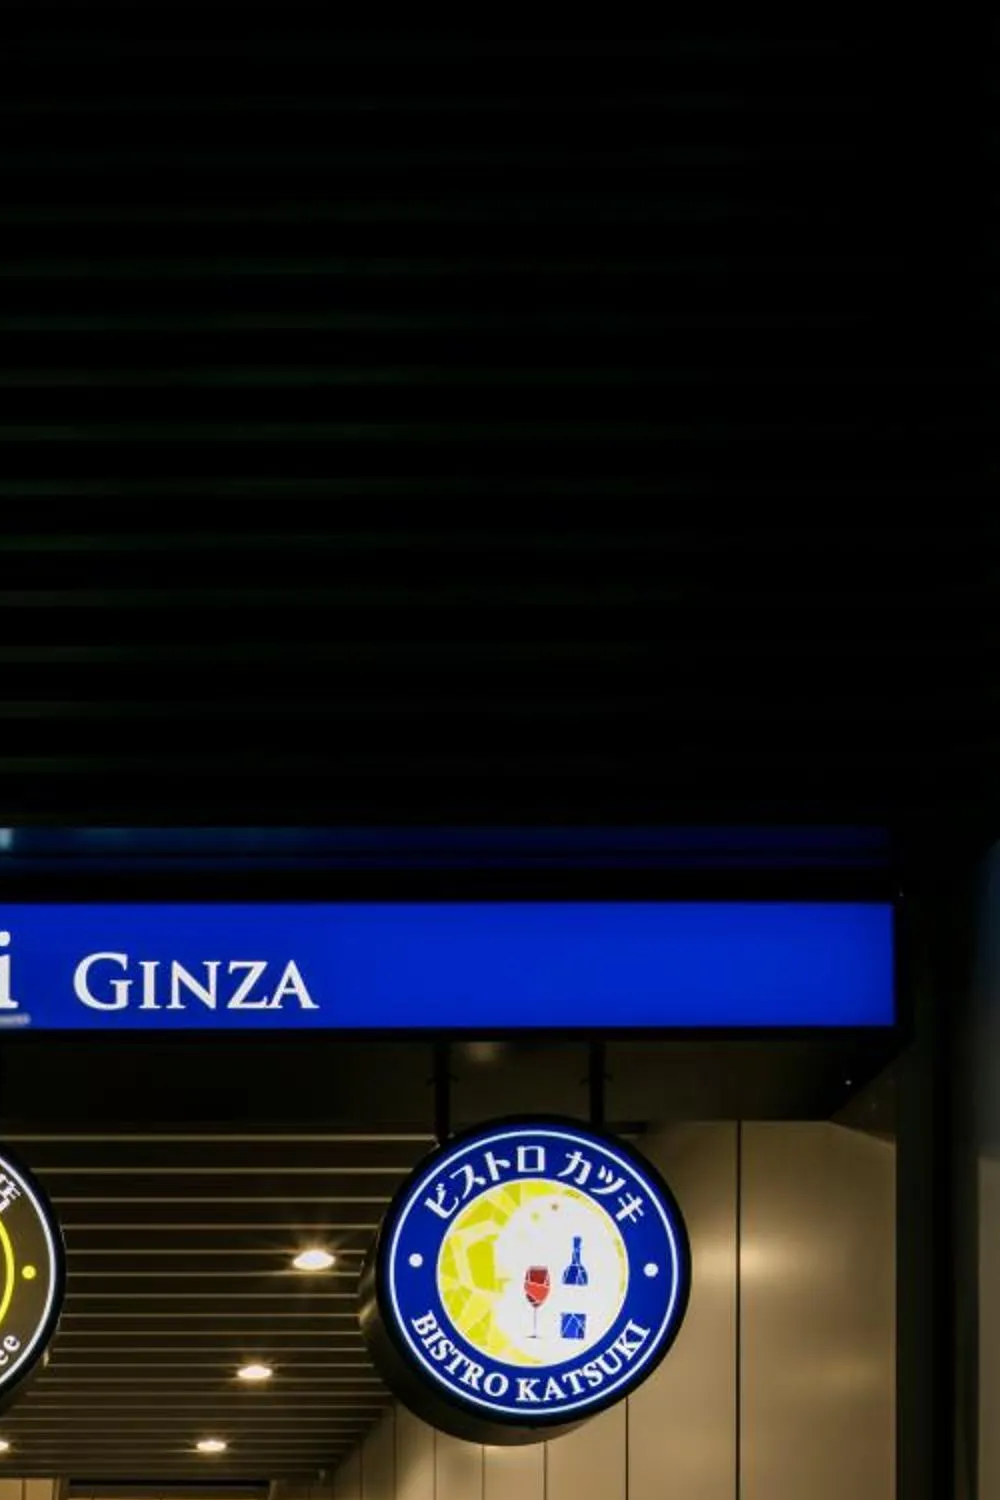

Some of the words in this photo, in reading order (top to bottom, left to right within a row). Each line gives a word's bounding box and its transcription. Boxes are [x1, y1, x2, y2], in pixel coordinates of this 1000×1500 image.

[73, 952, 320, 1010] GINZA
[424, 1145, 546, 1220] ビストロ
[411, 1310, 509, 1397] BISTRO
[516, 1319, 650, 1402] KATSUKI
